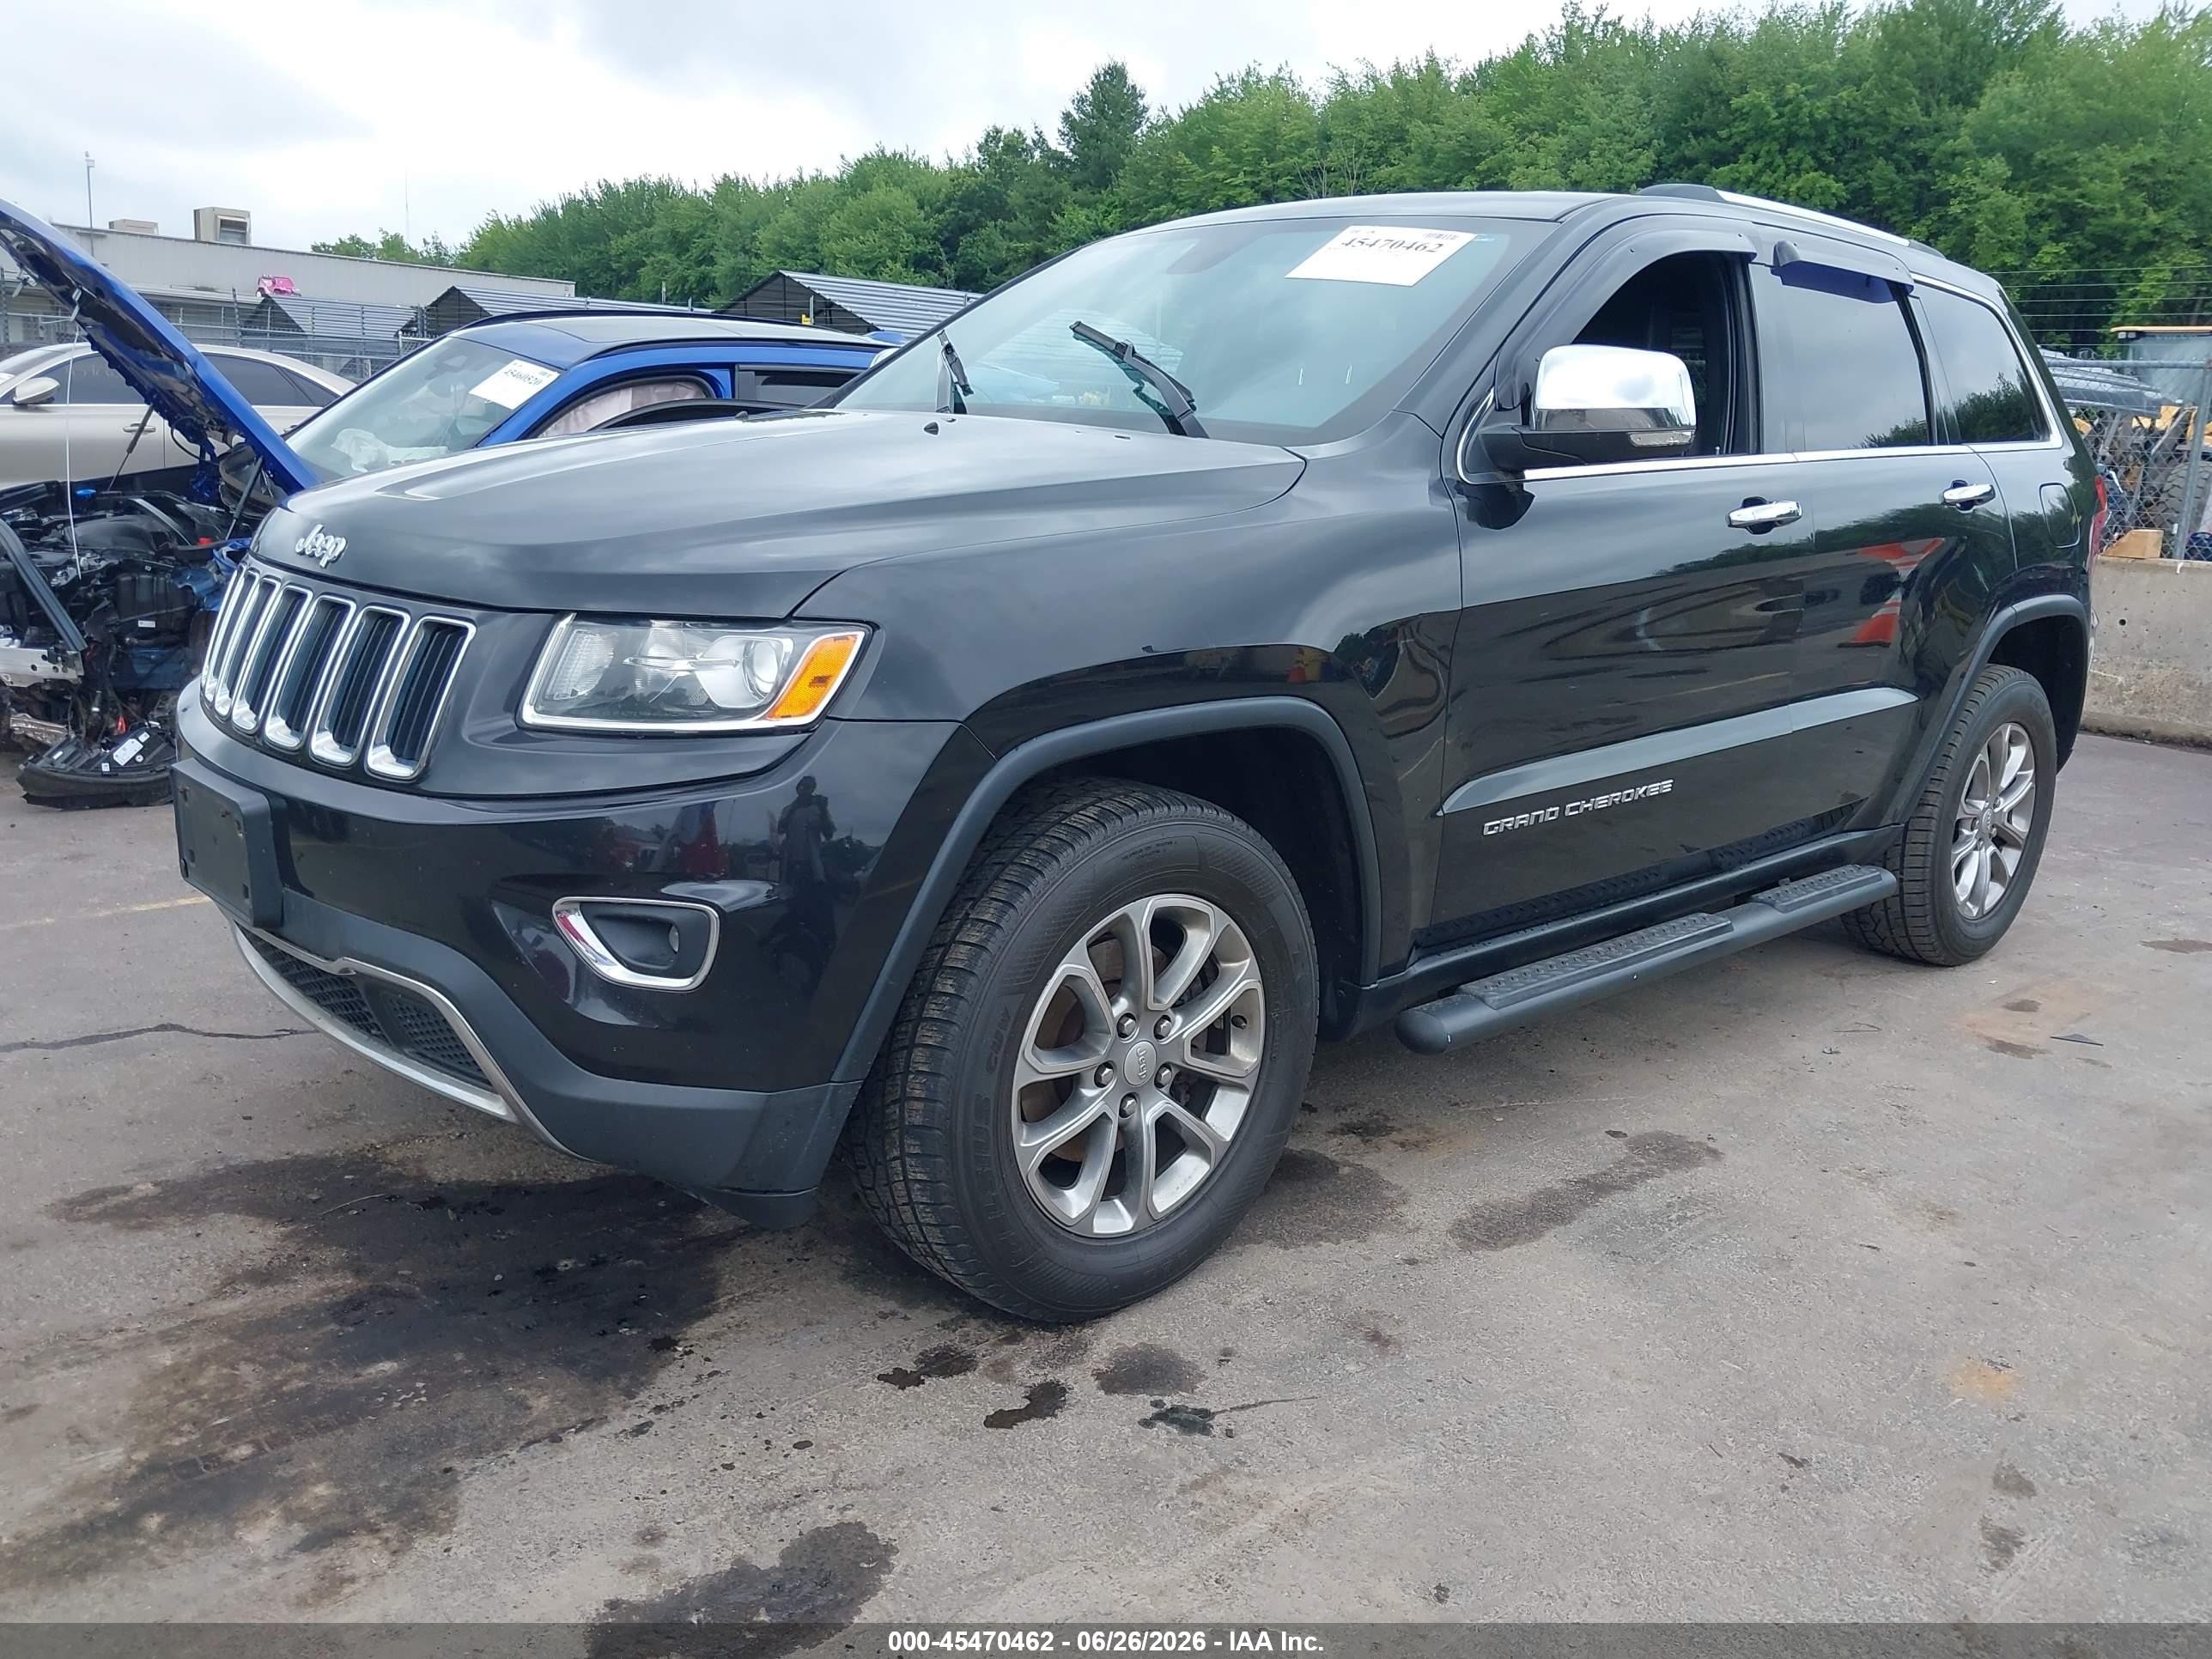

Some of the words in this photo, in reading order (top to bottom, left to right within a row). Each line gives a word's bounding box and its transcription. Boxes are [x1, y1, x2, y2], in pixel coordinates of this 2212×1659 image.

[1341, 237, 1444, 252] 45470462
[295, 523, 348, 568] Jeep
[1482, 806, 1560, 836] GRAND
[1564, 778, 1674, 817] CHEROKEE
[1136, 1047, 1147, 1080] Jeep
